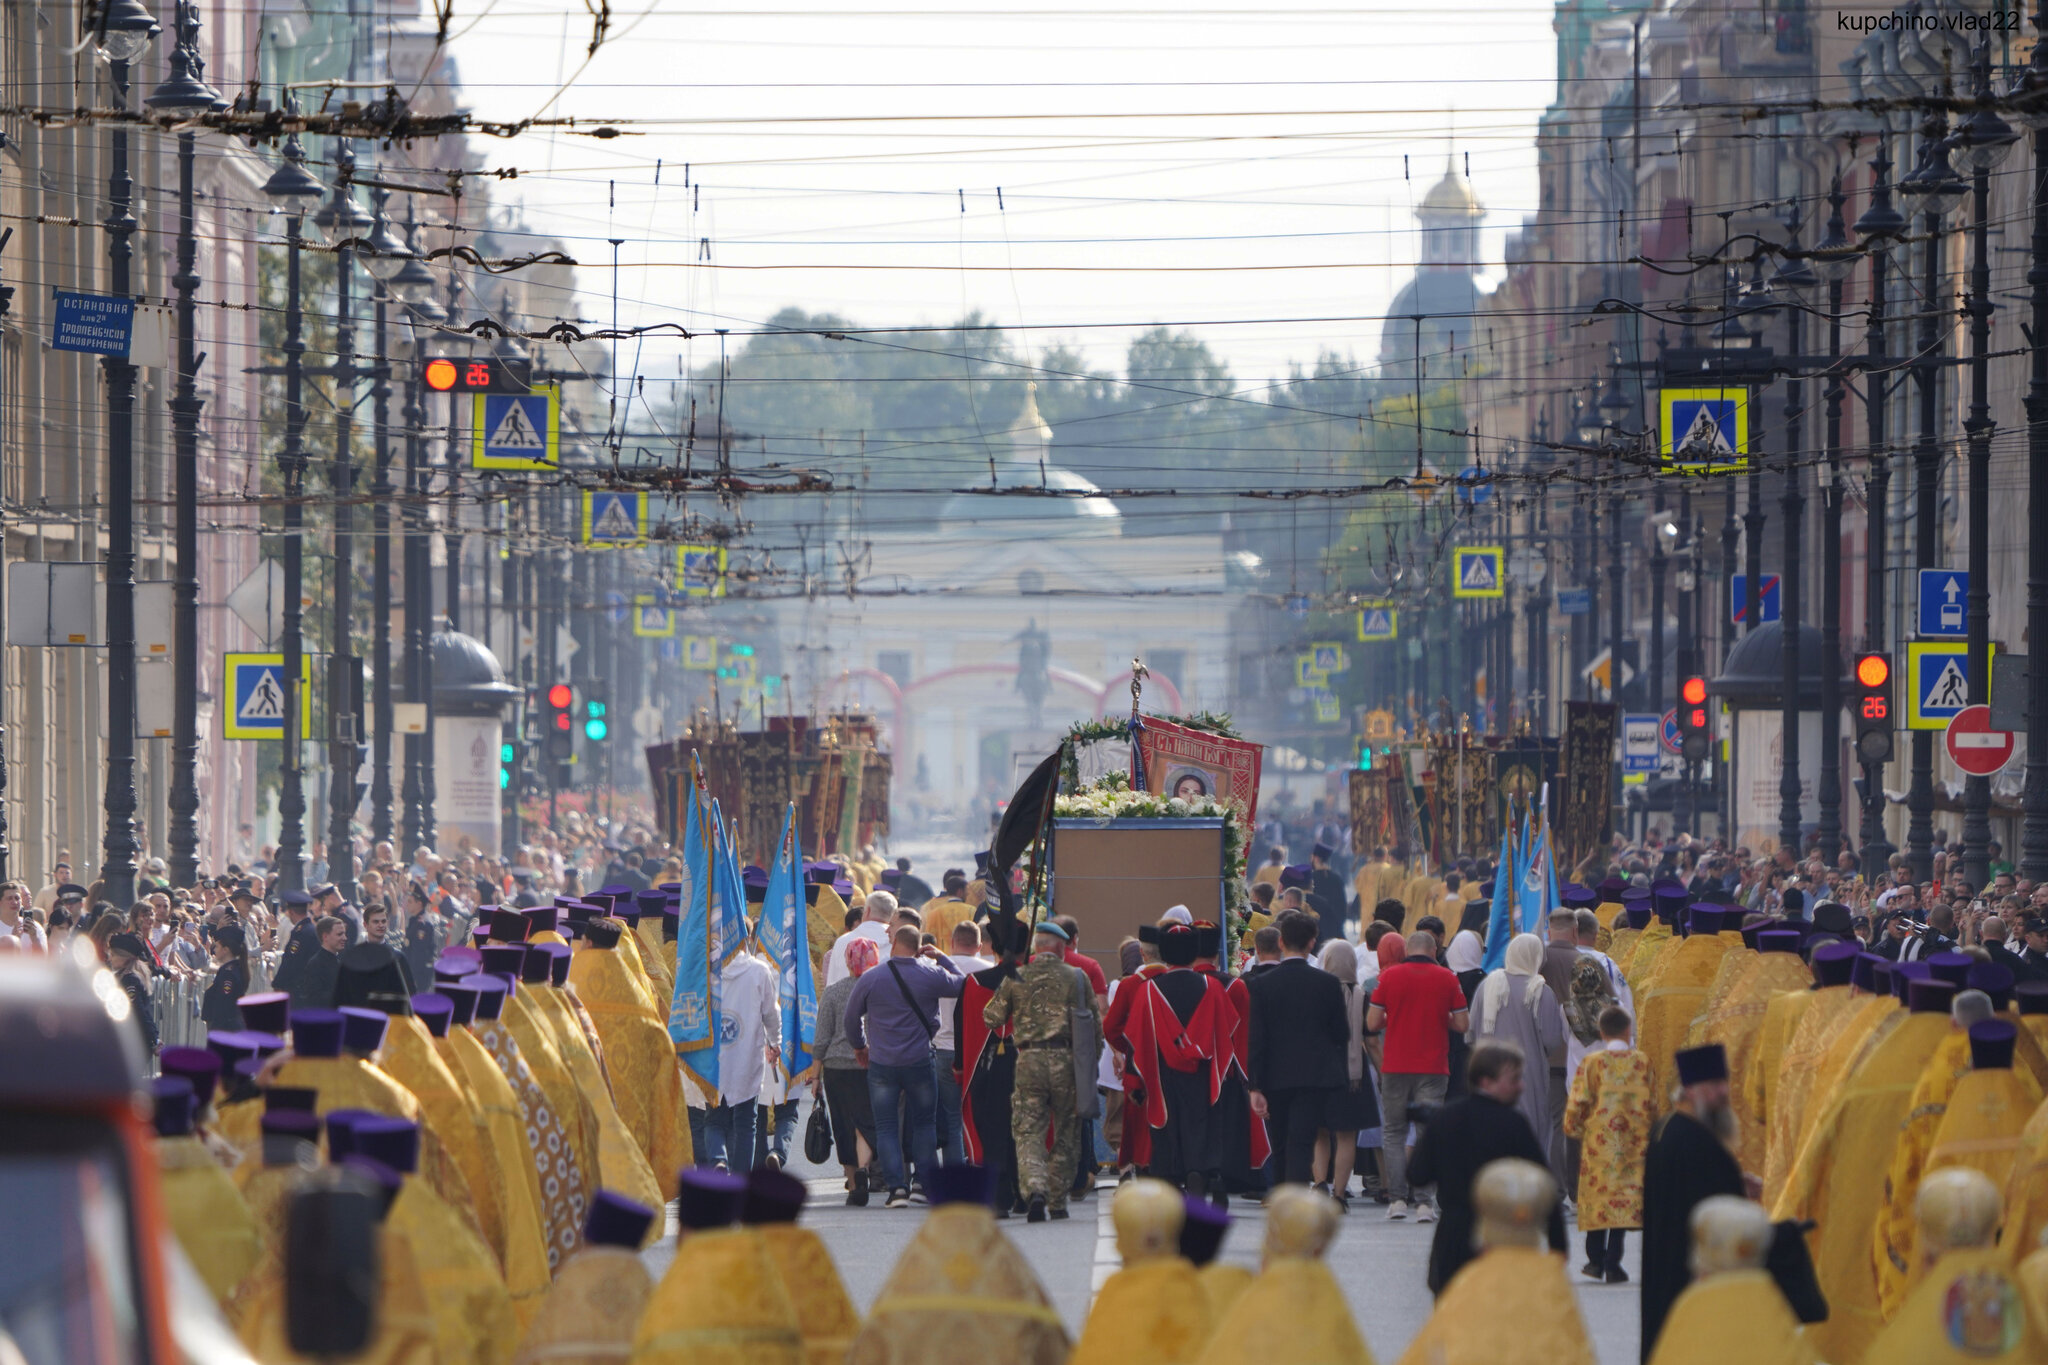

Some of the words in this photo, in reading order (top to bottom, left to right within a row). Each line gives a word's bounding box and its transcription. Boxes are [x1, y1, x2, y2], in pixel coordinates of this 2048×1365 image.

[63, 298, 128, 315] ОСТАНОВКА
[61, 322, 125, 340] ТРОЛЛЕЙБУСОВ
[59, 335, 124, 351] ОДНОВРЕМЕННО
[466, 364, 490, 386] 26
[1863, 696, 1887, 719] 26
